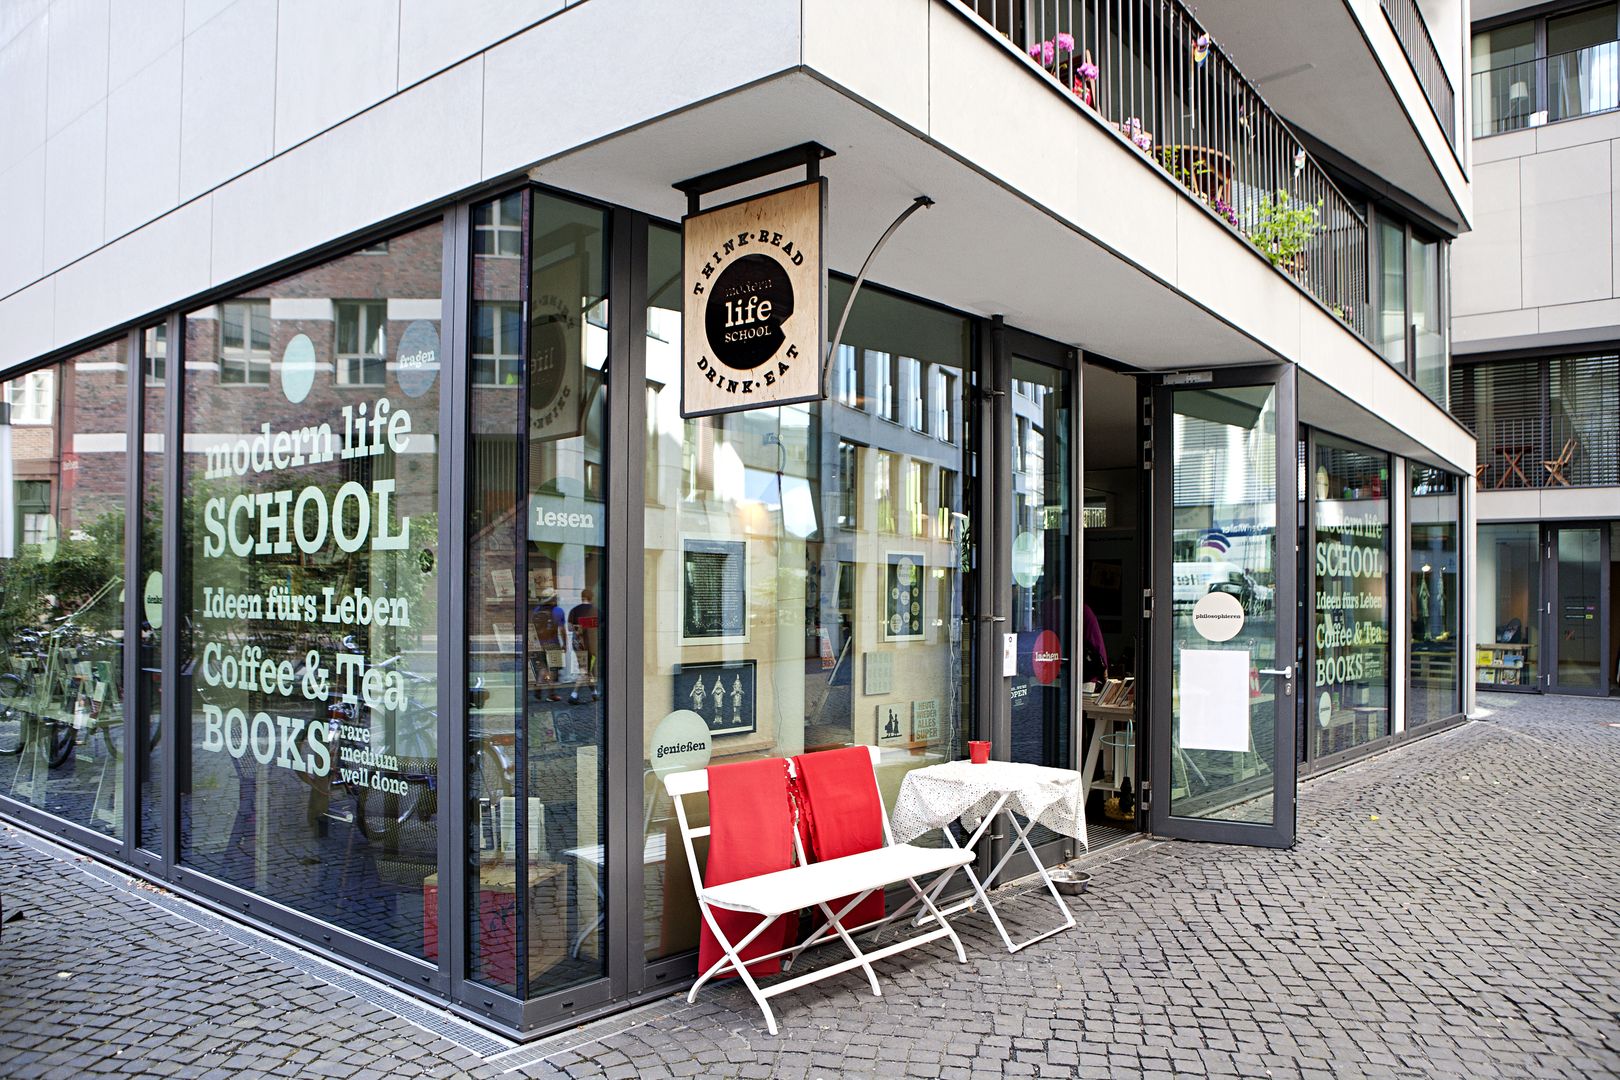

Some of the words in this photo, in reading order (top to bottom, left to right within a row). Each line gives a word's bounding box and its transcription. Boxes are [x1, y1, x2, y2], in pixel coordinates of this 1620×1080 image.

[725, 295, 772, 328] life
[724, 325, 772, 344] SCHOOL
[400, 350, 435, 369] fragen
[205, 422, 334, 480] modern
[340, 398, 412, 460] life
[203, 478, 410, 558] SCHOOL
[536, 507, 594, 529] lesen
[1364, 513, 1383, 539] life
[1316, 542, 1383, 578] SCHOOL
[203, 586, 264, 620] Ideen
[266, 585, 317, 623] fürs
[322, 587, 411, 628] Leben
[1316, 591, 1341, 610] Ideen
[1342, 591, 1359, 610] fürs
[1360, 592, 1383, 609] Leben
[1316, 622, 1352, 649] Coffee
[1353, 622, 1363, 646] &
[1363, 621, 1382, 644] Tea
[202, 642, 295, 697] Coffee
[302, 649, 329, 702] &
[336, 653, 409, 712] Tea
[1316, 653, 1363, 687] BOOKS
[202, 704, 331, 777] BOOKS
[340, 724, 371, 743] rare
[340, 746, 399, 771] medium
[656, 740, 706, 758] genießen
[340, 767, 369, 788] well
[371, 770, 409, 796] done
